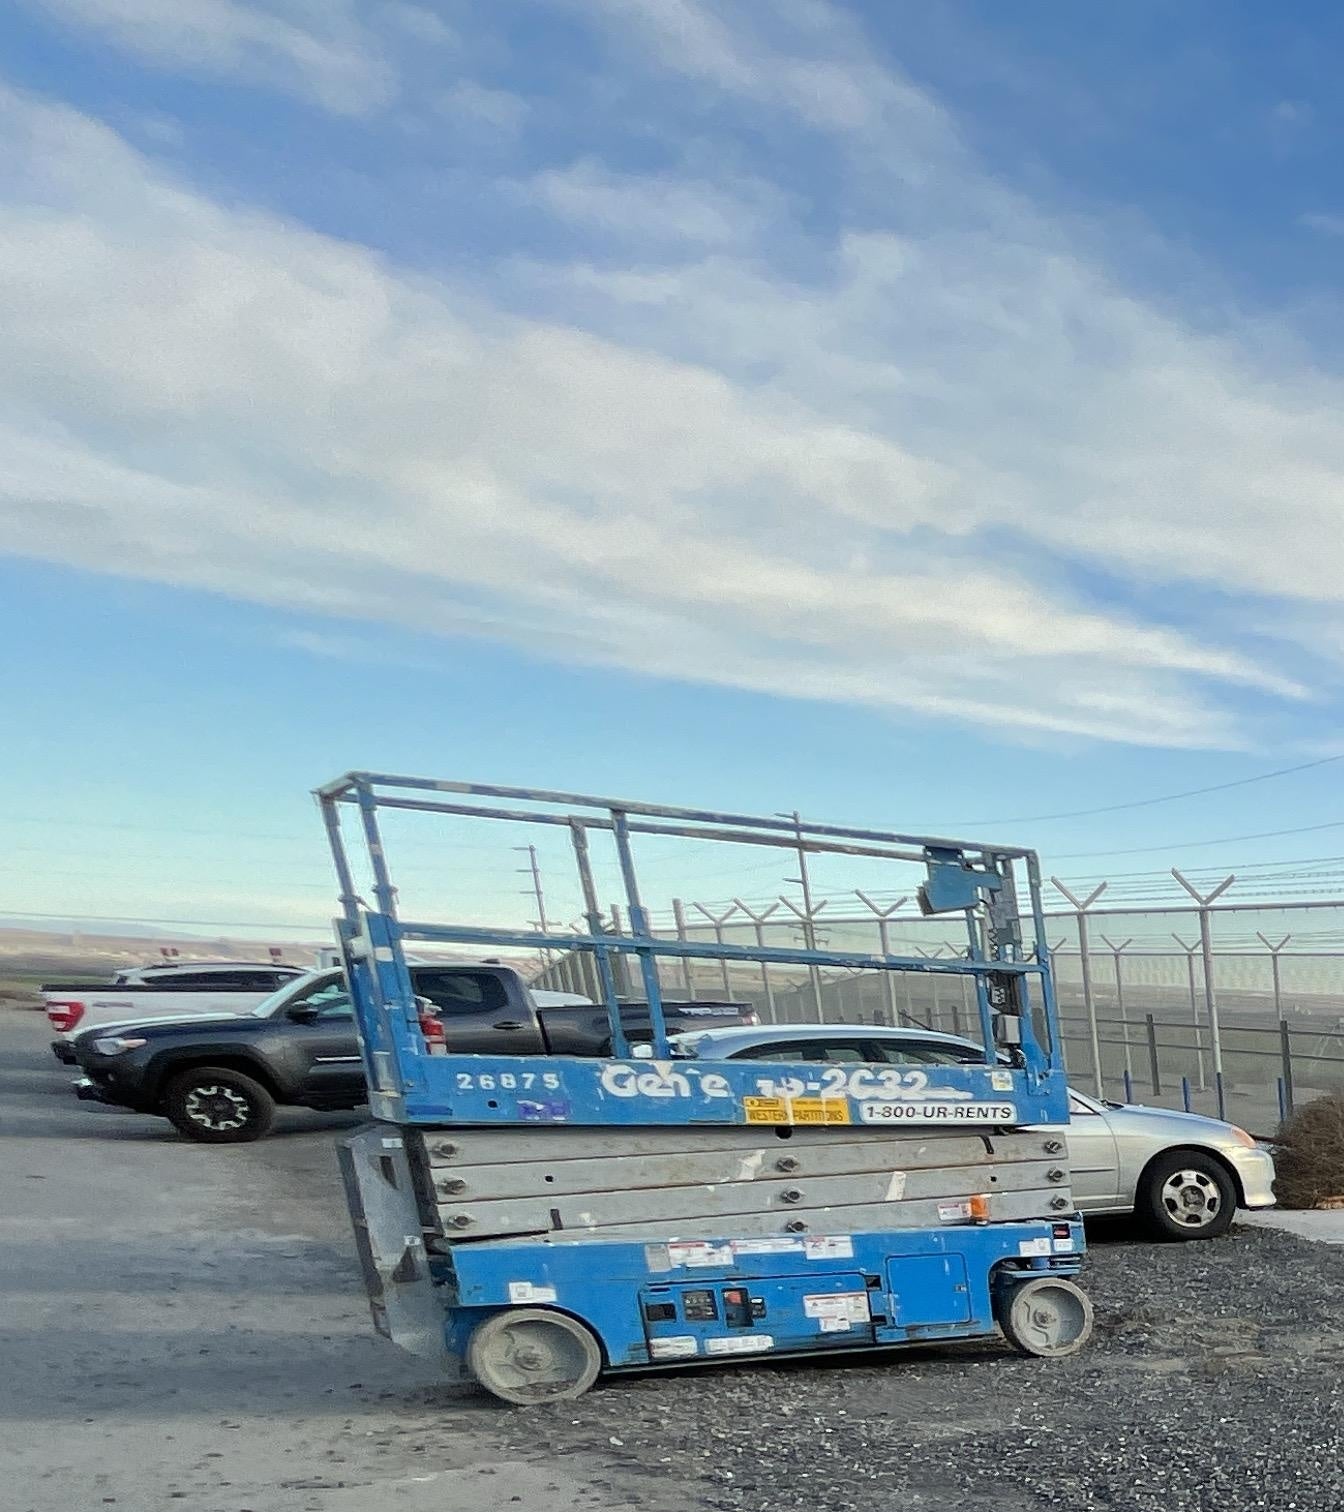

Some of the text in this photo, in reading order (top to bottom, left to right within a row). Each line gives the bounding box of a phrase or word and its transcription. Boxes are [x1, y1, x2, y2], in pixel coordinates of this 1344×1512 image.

[456, 1072, 560, 1091] 26875
[602, 1063, 730, 1098] Gene
[866, 1105, 1013, 1120] 1-800-UR-RENTS
